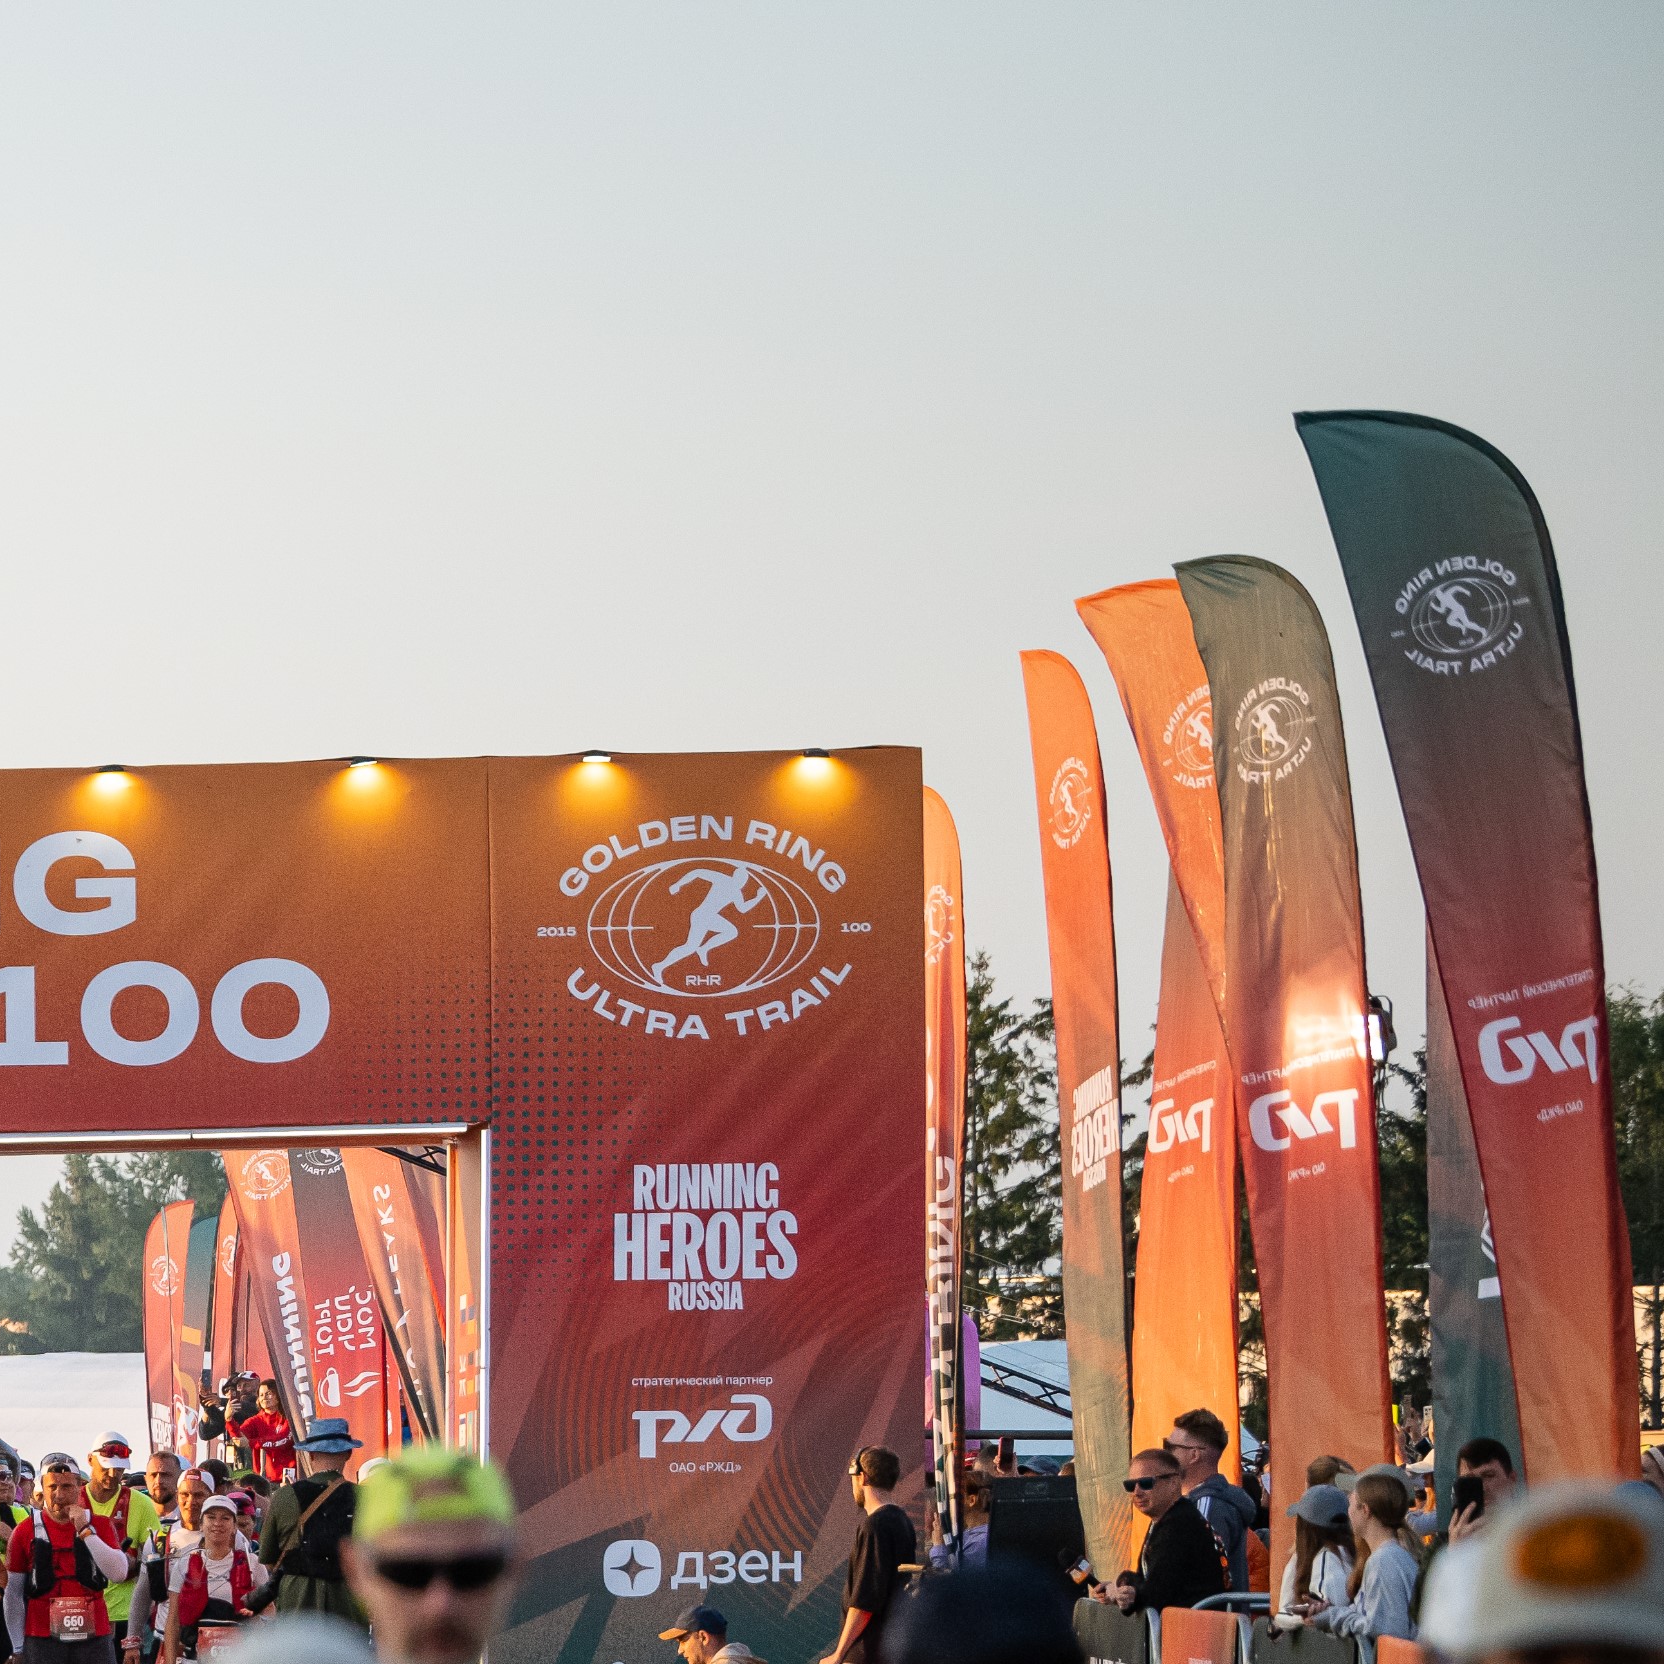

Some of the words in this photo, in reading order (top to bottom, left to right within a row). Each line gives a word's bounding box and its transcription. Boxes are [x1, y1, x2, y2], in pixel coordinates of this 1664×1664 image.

[559, 815, 733, 897] GOLDEN
[745, 819, 847, 893] RING
[537, 926, 576, 937] 2015
[840, 922, 872, 933] 100
[685, 974, 722, 986] RHR
[566, 966, 710, 1040] ULTRA
[724, 962, 852, 1036] TRAIL
[633, 1162, 780, 1211] RUNNING
[613, 1210, 799, 1280] HEROES
[668, 1281, 744, 1311] RUSSIA
[631, 1375, 723, 1388] стратегический
[725, 1376, 773, 1387] партнер
[669, 1462, 696, 1472] ОАО
[699, 1462, 741, 1473] «РЖД»
[63, 1615, 84, 1627] 660
